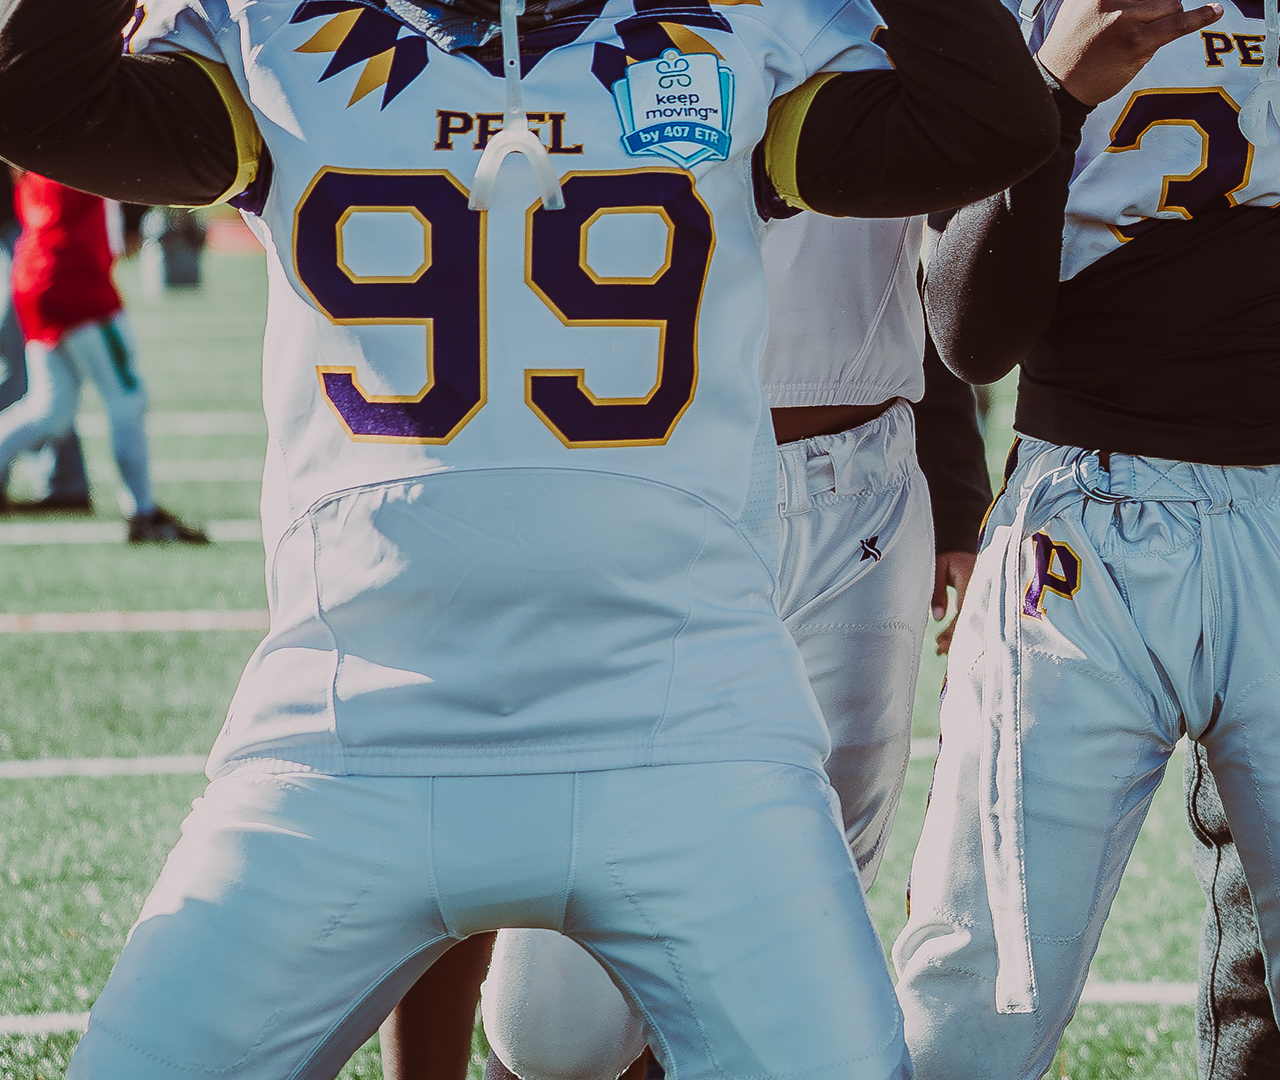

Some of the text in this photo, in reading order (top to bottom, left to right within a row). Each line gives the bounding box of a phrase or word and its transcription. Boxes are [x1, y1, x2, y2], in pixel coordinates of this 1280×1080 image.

[656, 93, 700, 106] keep
[639, 126, 719, 144] by 407 ETR
[293, 165, 716, 448] 99
